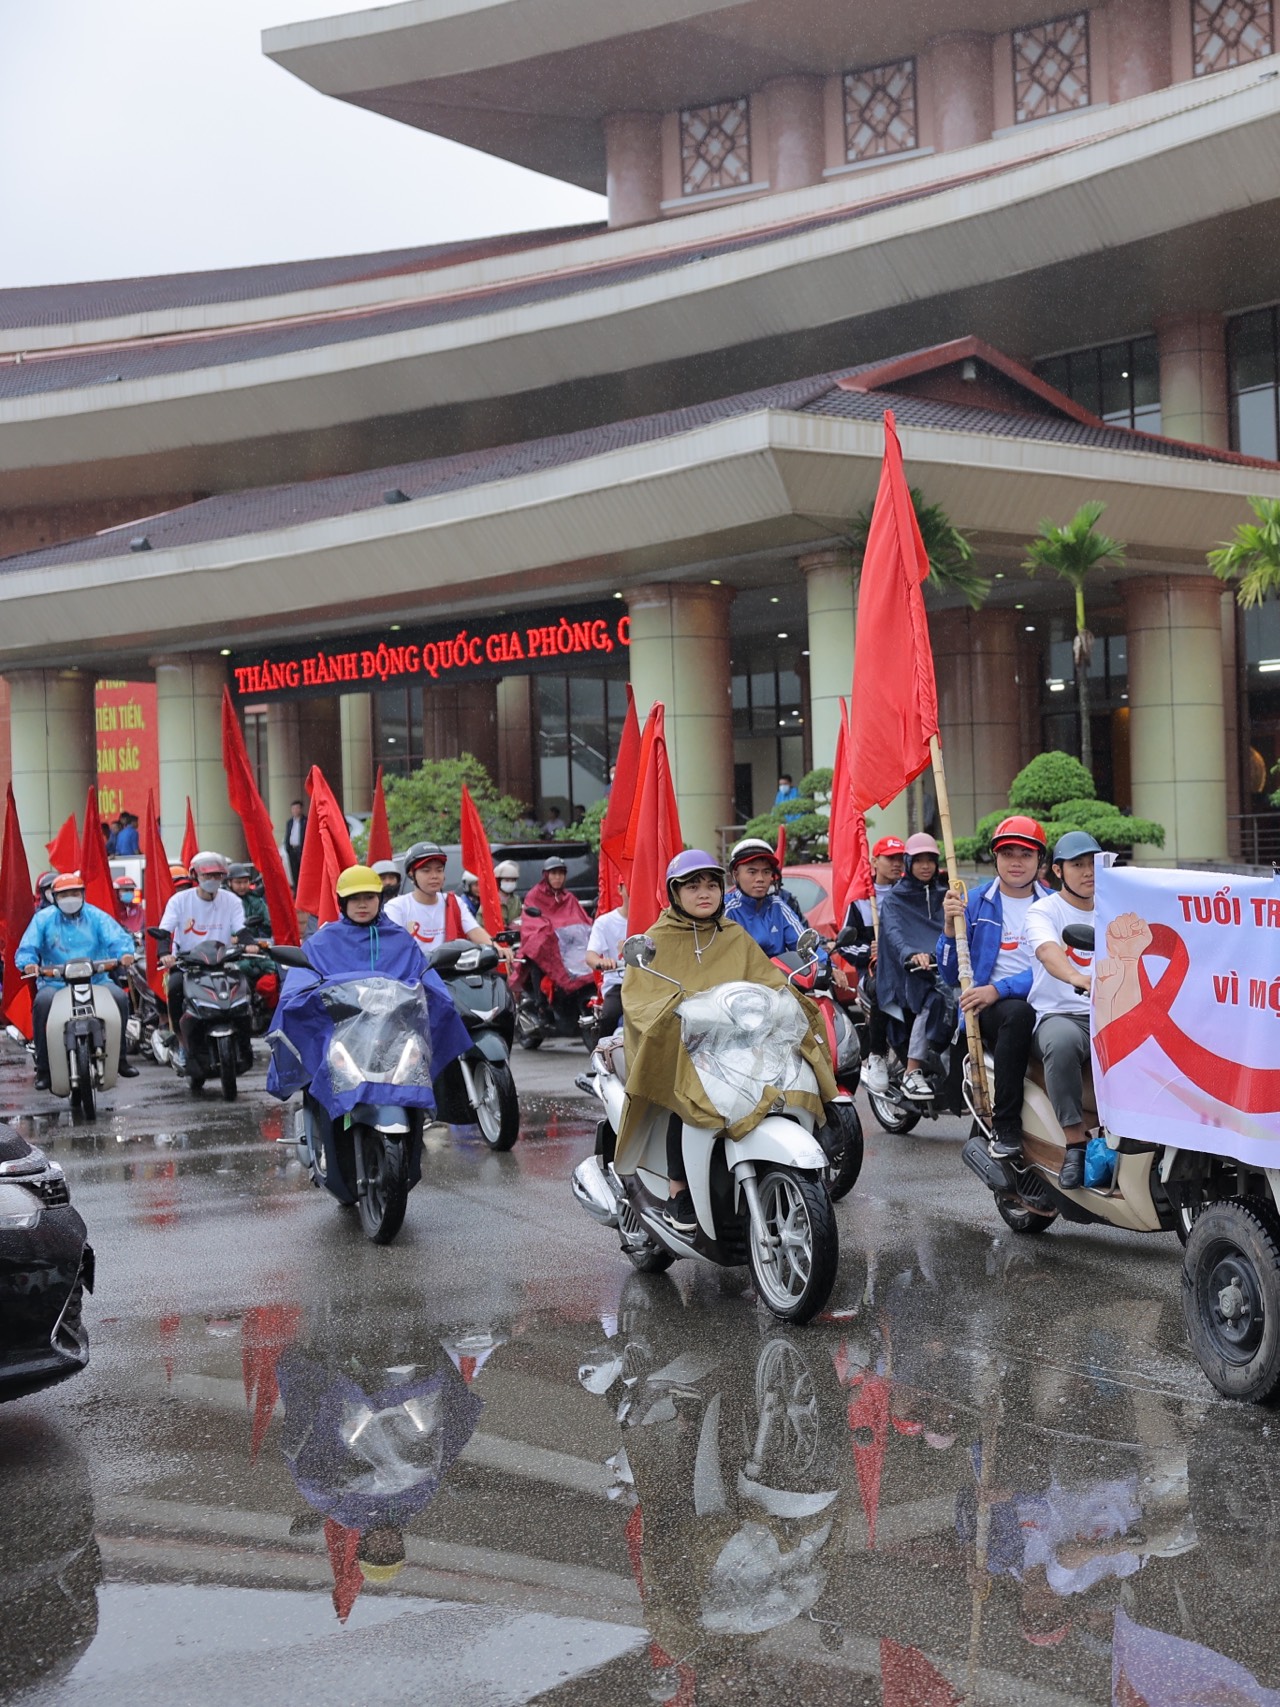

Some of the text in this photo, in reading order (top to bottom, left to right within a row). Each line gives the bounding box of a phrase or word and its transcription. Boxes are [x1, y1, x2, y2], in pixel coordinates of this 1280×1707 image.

[234, 659, 301, 694] THÁNG
[301, 651, 359, 686] HÀNH
[360, 642, 421, 682] ĐỘNG
[422, 630, 484, 679] QUỐC
[485, 631, 525, 662] GIA
[526, 617, 614, 654] PHÒNG,
[118, 736, 140, 772] SẮC
[1177, 885, 1241, 926] TUỔI
[1212, 970, 1239, 1005] VÌ
